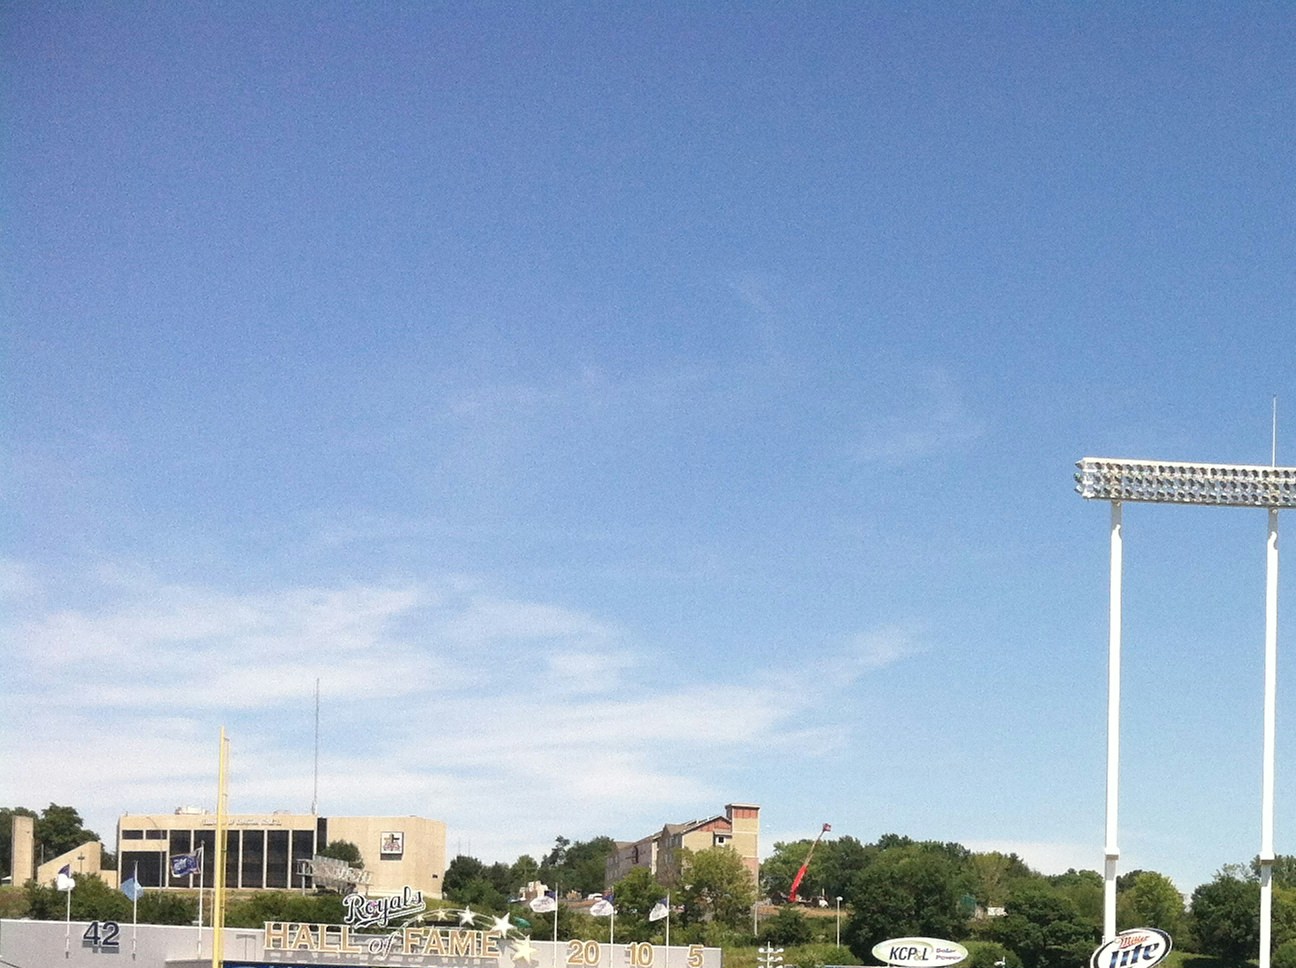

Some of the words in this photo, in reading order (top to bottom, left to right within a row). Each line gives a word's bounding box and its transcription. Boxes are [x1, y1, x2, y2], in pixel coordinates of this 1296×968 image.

[343, 887, 426, 928] Royals
[83, 921, 120, 946] 42
[264, 921, 362, 953] HALL
[368, 931, 398, 960] of
[402, 928, 501, 958] FAME
[567, 939, 601, 966] 20
[627, 942, 654, 967] 10
[889, 947, 929, 960] KCP&L
